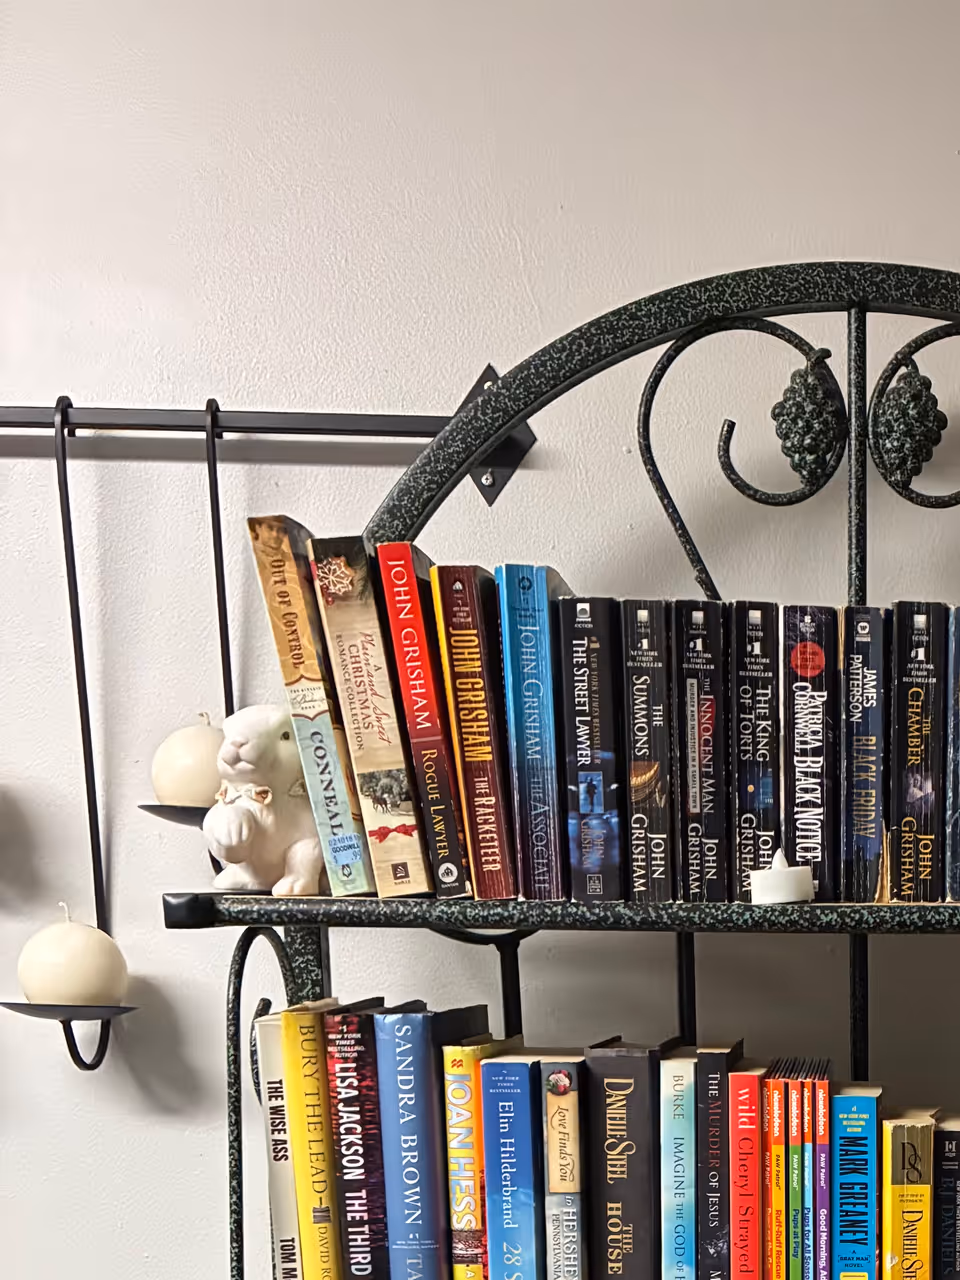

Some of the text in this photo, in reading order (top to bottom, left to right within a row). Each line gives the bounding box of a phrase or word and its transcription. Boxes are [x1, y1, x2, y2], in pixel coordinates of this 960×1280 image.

[386, 560, 432, 730] JOHN GRISHAM
[573, 637, 588, 664] THE
[348, 644, 374, 730] CHRISTMAS
[449, 627, 493, 763] JOHN GRISHAM
[574, 667, 589, 712] STREET
[591, 672, 599, 691] YORK
[592, 693, 600, 716] TIMES
[849, 654, 862, 722] PATTERSON
[863, 667, 877, 708] JAMES
[576, 716, 591, 766] LAWYER
[631, 675, 651, 757] SUMMONS
[700, 694, 716, 774] INNOCENT
[808, 690, 827, 750] PATRICIA
[907, 688, 923, 767] CHAMBER
[691, 755, 697, 763] IN
[702, 777, 715, 814] MAN
[794, 756, 824, 862] BLACK NOTICE
[332, 844, 360, 853] GOODWILL
[631, 813, 648, 893] GRISHAM
[647, 832, 667, 880] JOHN
[687, 823, 702, 893] GRISHAM
[702, 838, 718, 880] JOHN
[901, 817, 917, 897] GRISHAM
[918, 835, 935, 880] JOHN
[267, 1079, 289, 1162] THE WISE ASS
[299, 1024, 328, 1194] BURY THE LEAD
[334, 1062, 365, 1180] LISA JACKSON
[673, 1074, 685, 1120] BURKE
[394, 1025, 423, 1226] SANDRA BROWN
[445, 1072, 477, 1230] JOAN HESS
[497, 1101, 519, 1229] Elin Hilderbrand
[673, 1137, 686, 1198] IMAGINE
[839, 1136, 869, 1177] MARK
[345, 1189, 368, 1221] THE
[565, 1195, 572, 1206] in
[676, 1202, 684, 1221] THE
[839, 1182, 869, 1247] GREANEY
[347, 1223, 370, 1276] THIRD
[503, 1242, 522, 1266] 28
[552, 1213, 561, 1280] PENNSYLVANIA
[606, 1201, 624, 1275] HOUSE
[622, 1223, 634, 1254] THE
[673, 1223, 686, 1258] GOD
[465, 1270, 473, 1278] A
[676, 1260, 684, 1273] OF
